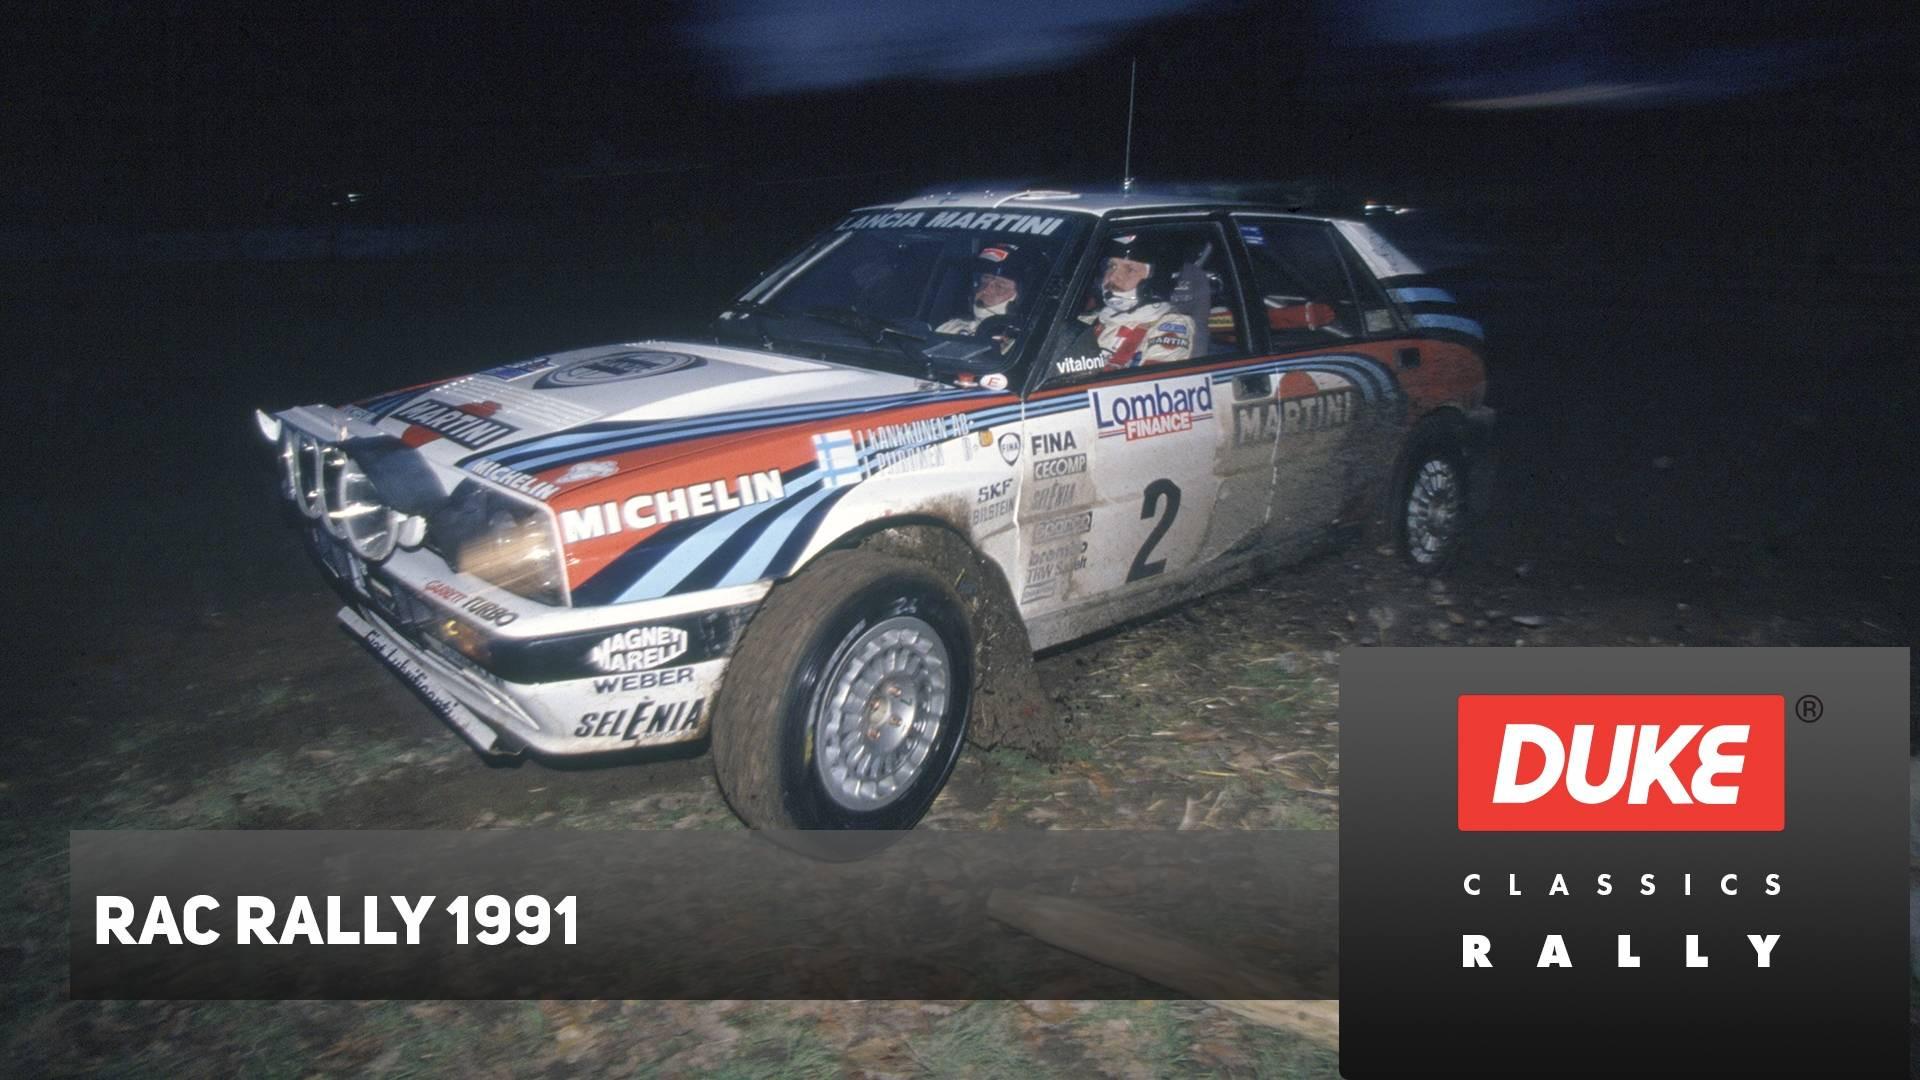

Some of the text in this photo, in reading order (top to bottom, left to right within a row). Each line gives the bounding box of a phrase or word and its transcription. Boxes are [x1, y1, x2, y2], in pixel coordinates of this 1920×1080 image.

[837, 212, 1064, 236] LANCIA MARTINI
[1056, 353, 1105, 374] vitaloni
[1093, 376, 1213, 429] Lombard
[1238, 391, 1356, 443] MARTINI
[402, 401, 509, 446] MARTINI
[1126, 412, 1191, 439] FINANCE
[1031, 430, 1077, 456] FINA
[472, 460, 560, 498] MICHELIN
[1034, 455, 1086, 479] CECOMP
[978, 478, 1013, 503] SKF
[560, 468, 785, 543] MICHELIN
[973, 497, 1015, 526] BILSTEIN
[1126, 478, 1181, 583] 2
[462, 595, 519, 627] TURBO
[594, 667, 694, 694] WEBER
